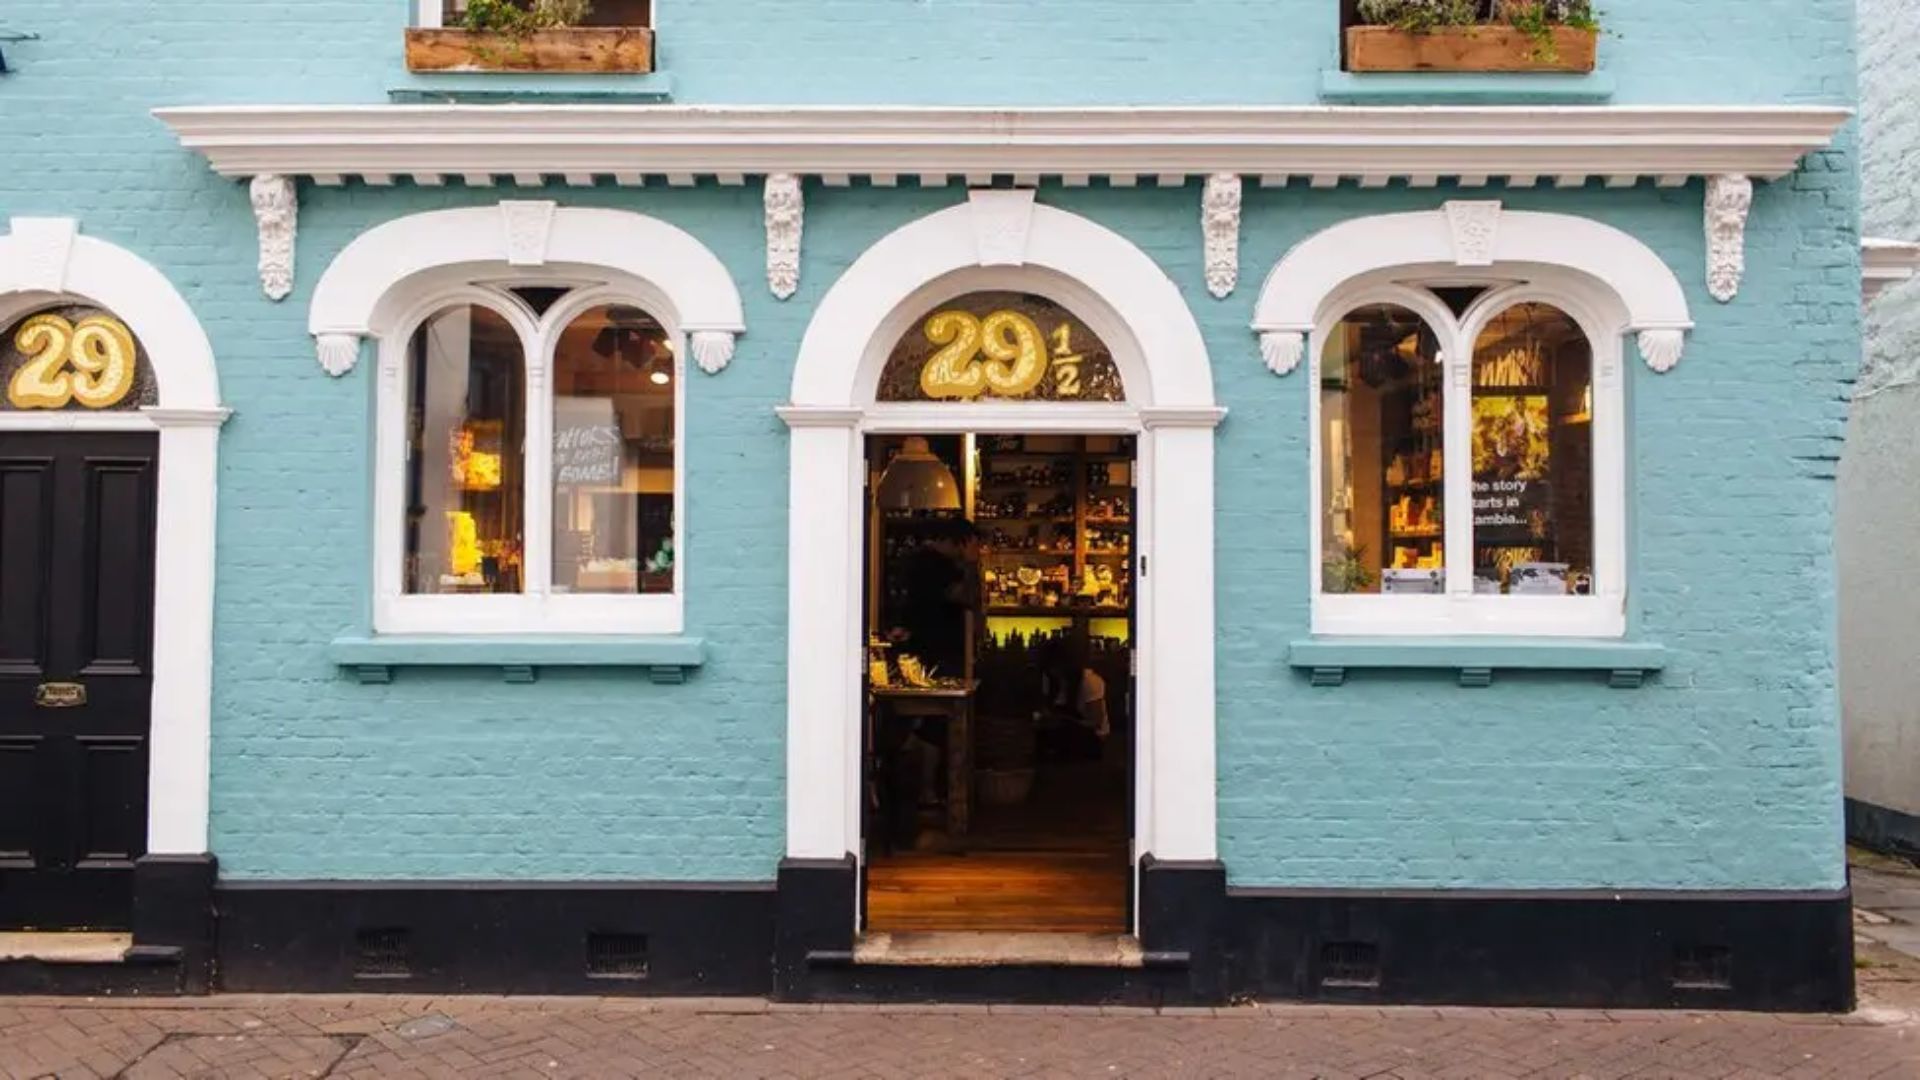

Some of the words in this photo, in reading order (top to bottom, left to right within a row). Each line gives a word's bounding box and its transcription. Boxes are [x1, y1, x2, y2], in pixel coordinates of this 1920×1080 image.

[920, 309, 1048, 398] 29
[8, 314, 136, 408] 29
[1472, 480, 1490, 492] he
[1492, 480, 1527, 492] story
[1472, 496, 1504, 509] tarts
[1506, 495, 1520, 507] in
[1474, 513, 1528, 525] ambia...
